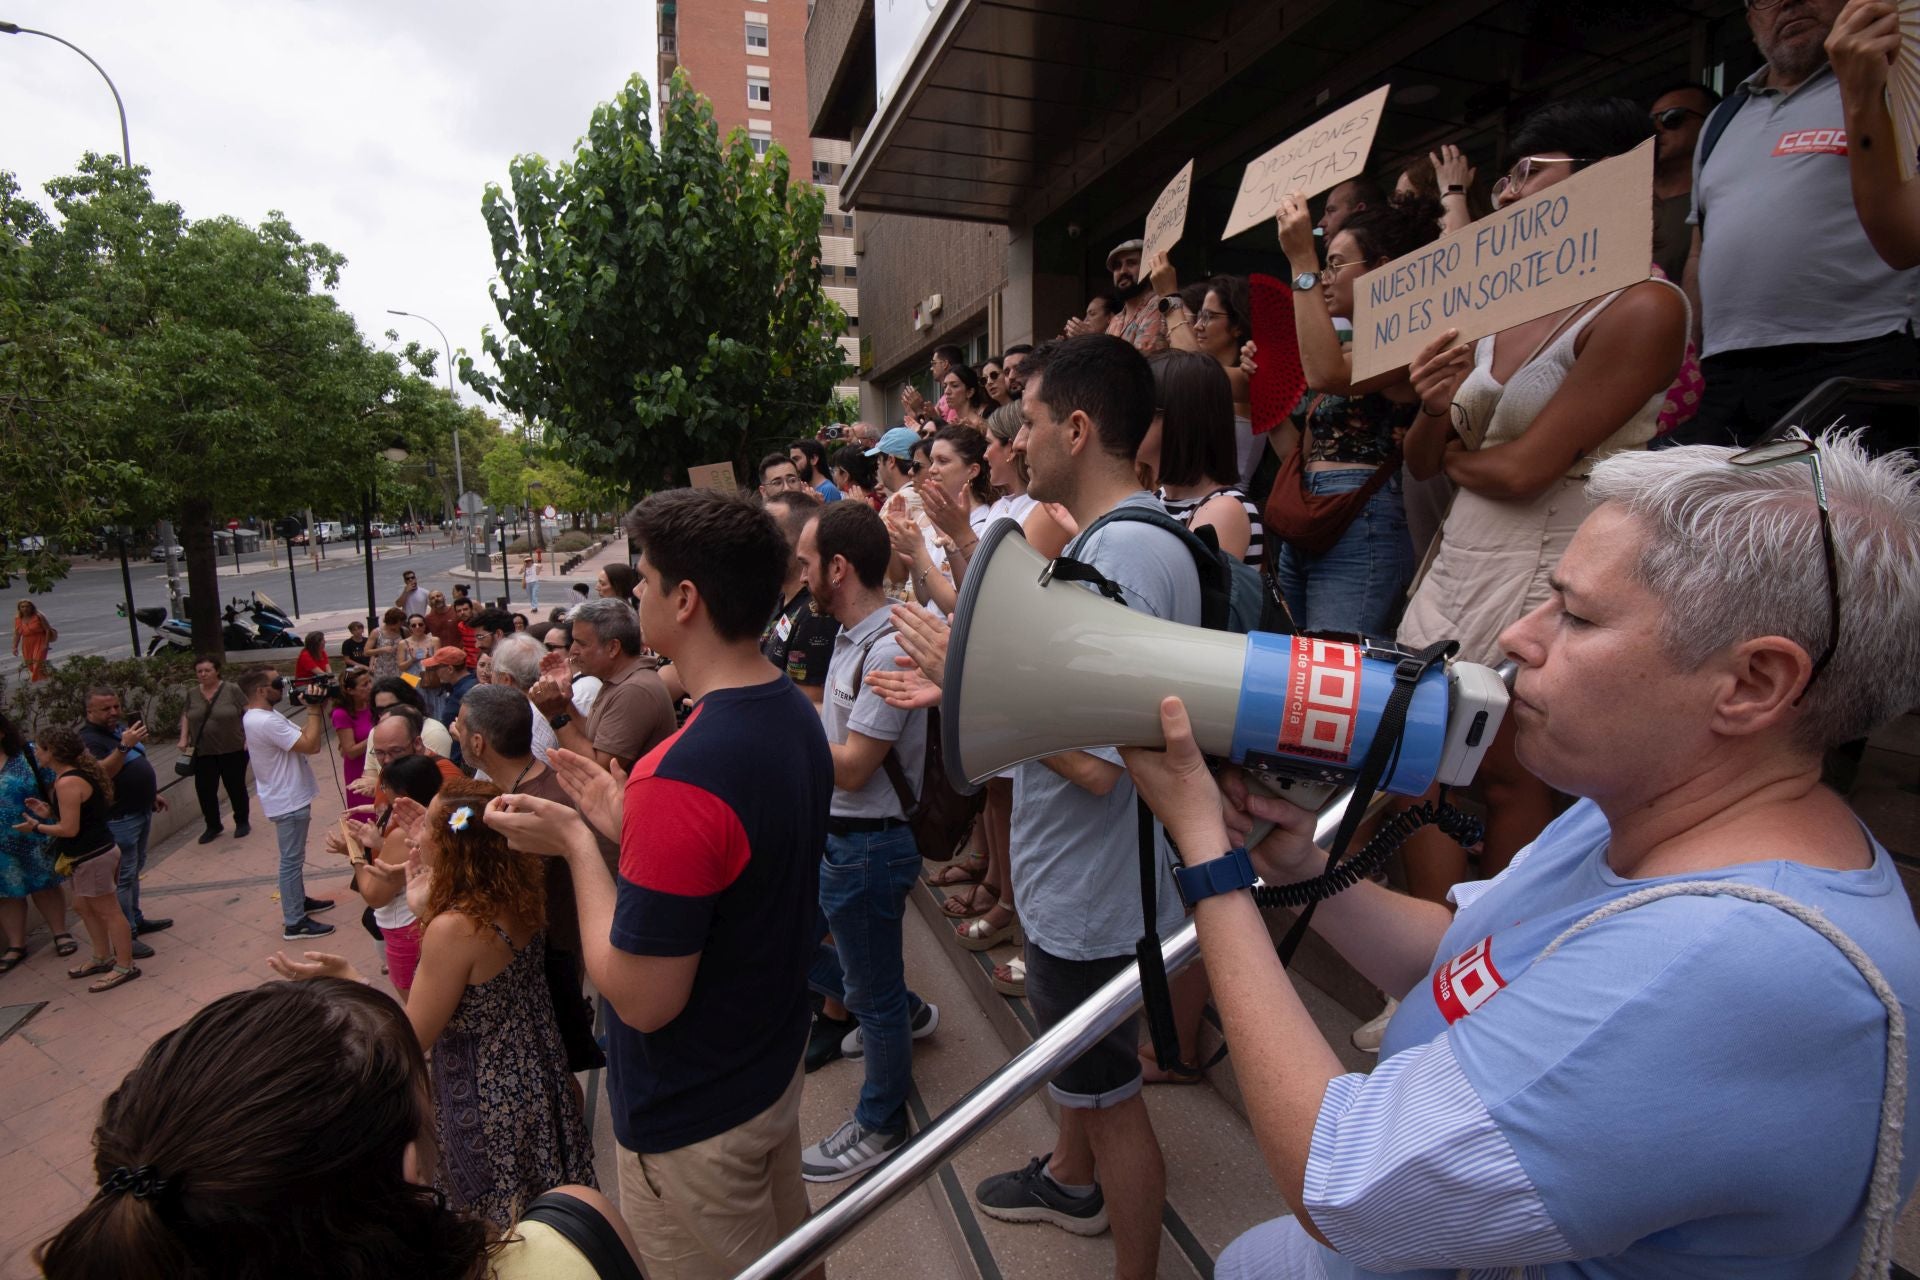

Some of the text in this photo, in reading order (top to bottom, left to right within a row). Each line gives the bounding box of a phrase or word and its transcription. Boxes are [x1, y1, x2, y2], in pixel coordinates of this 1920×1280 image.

[1248, 136, 1362, 218] JUSTAS
[1371, 196, 1569, 308] NUESTRO FUTURO
[1375, 313, 1400, 350] NO
[1408, 299, 1432, 333] ES
[1298, 654, 1310, 668] de
[1290, 672, 1307, 725] murcia
